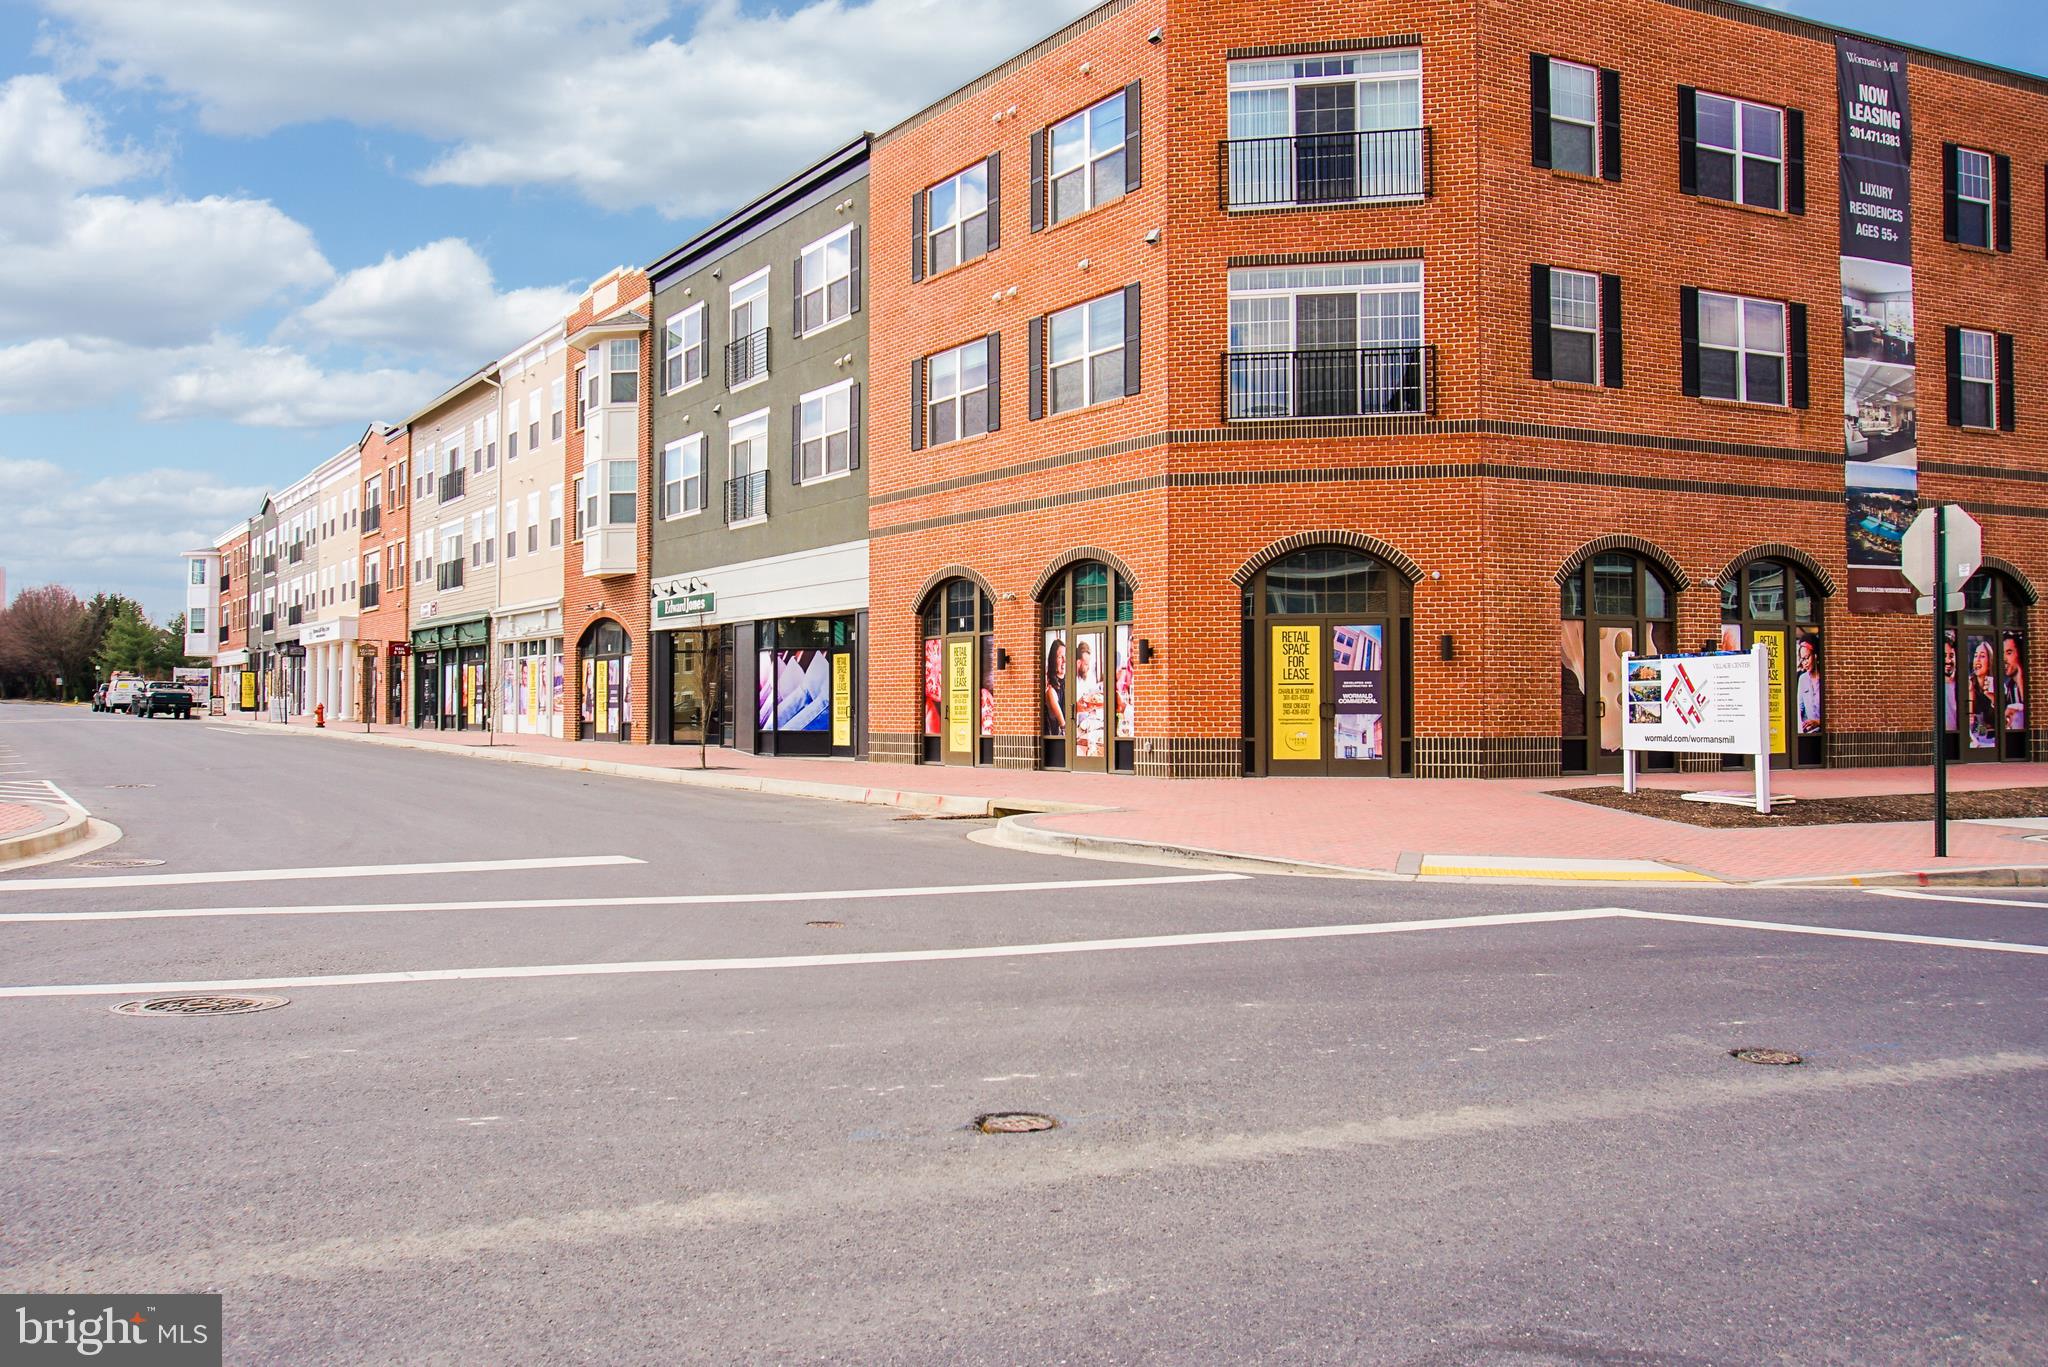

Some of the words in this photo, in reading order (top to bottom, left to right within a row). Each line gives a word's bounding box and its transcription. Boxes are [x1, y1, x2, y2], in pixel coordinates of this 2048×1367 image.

[1846, 51, 1881, 68] Worman's
[1883, 60, 1899, 72] Mill
[1859, 84, 1888, 106] NOW
[1849, 101, 1901, 129] LEASING
[1850, 125, 1900, 147] 301.471.1383
[1860, 181, 1893, 200] LUXURY
[1850, 200, 1904, 222] RESIDENCES
[1856, 222, 1879, 239] AGES
[1881, 227, 1899, 241] 55+
[1281, 631, 1311, 643] RETAIL
[1282, 643, 1310, 655] SPACE
[1287, 655, 1305, 667] FOR
[1282, 668, 1310, 680] LEASE
[1644, 734, 1735, 744] wormald.com/wormansmill
